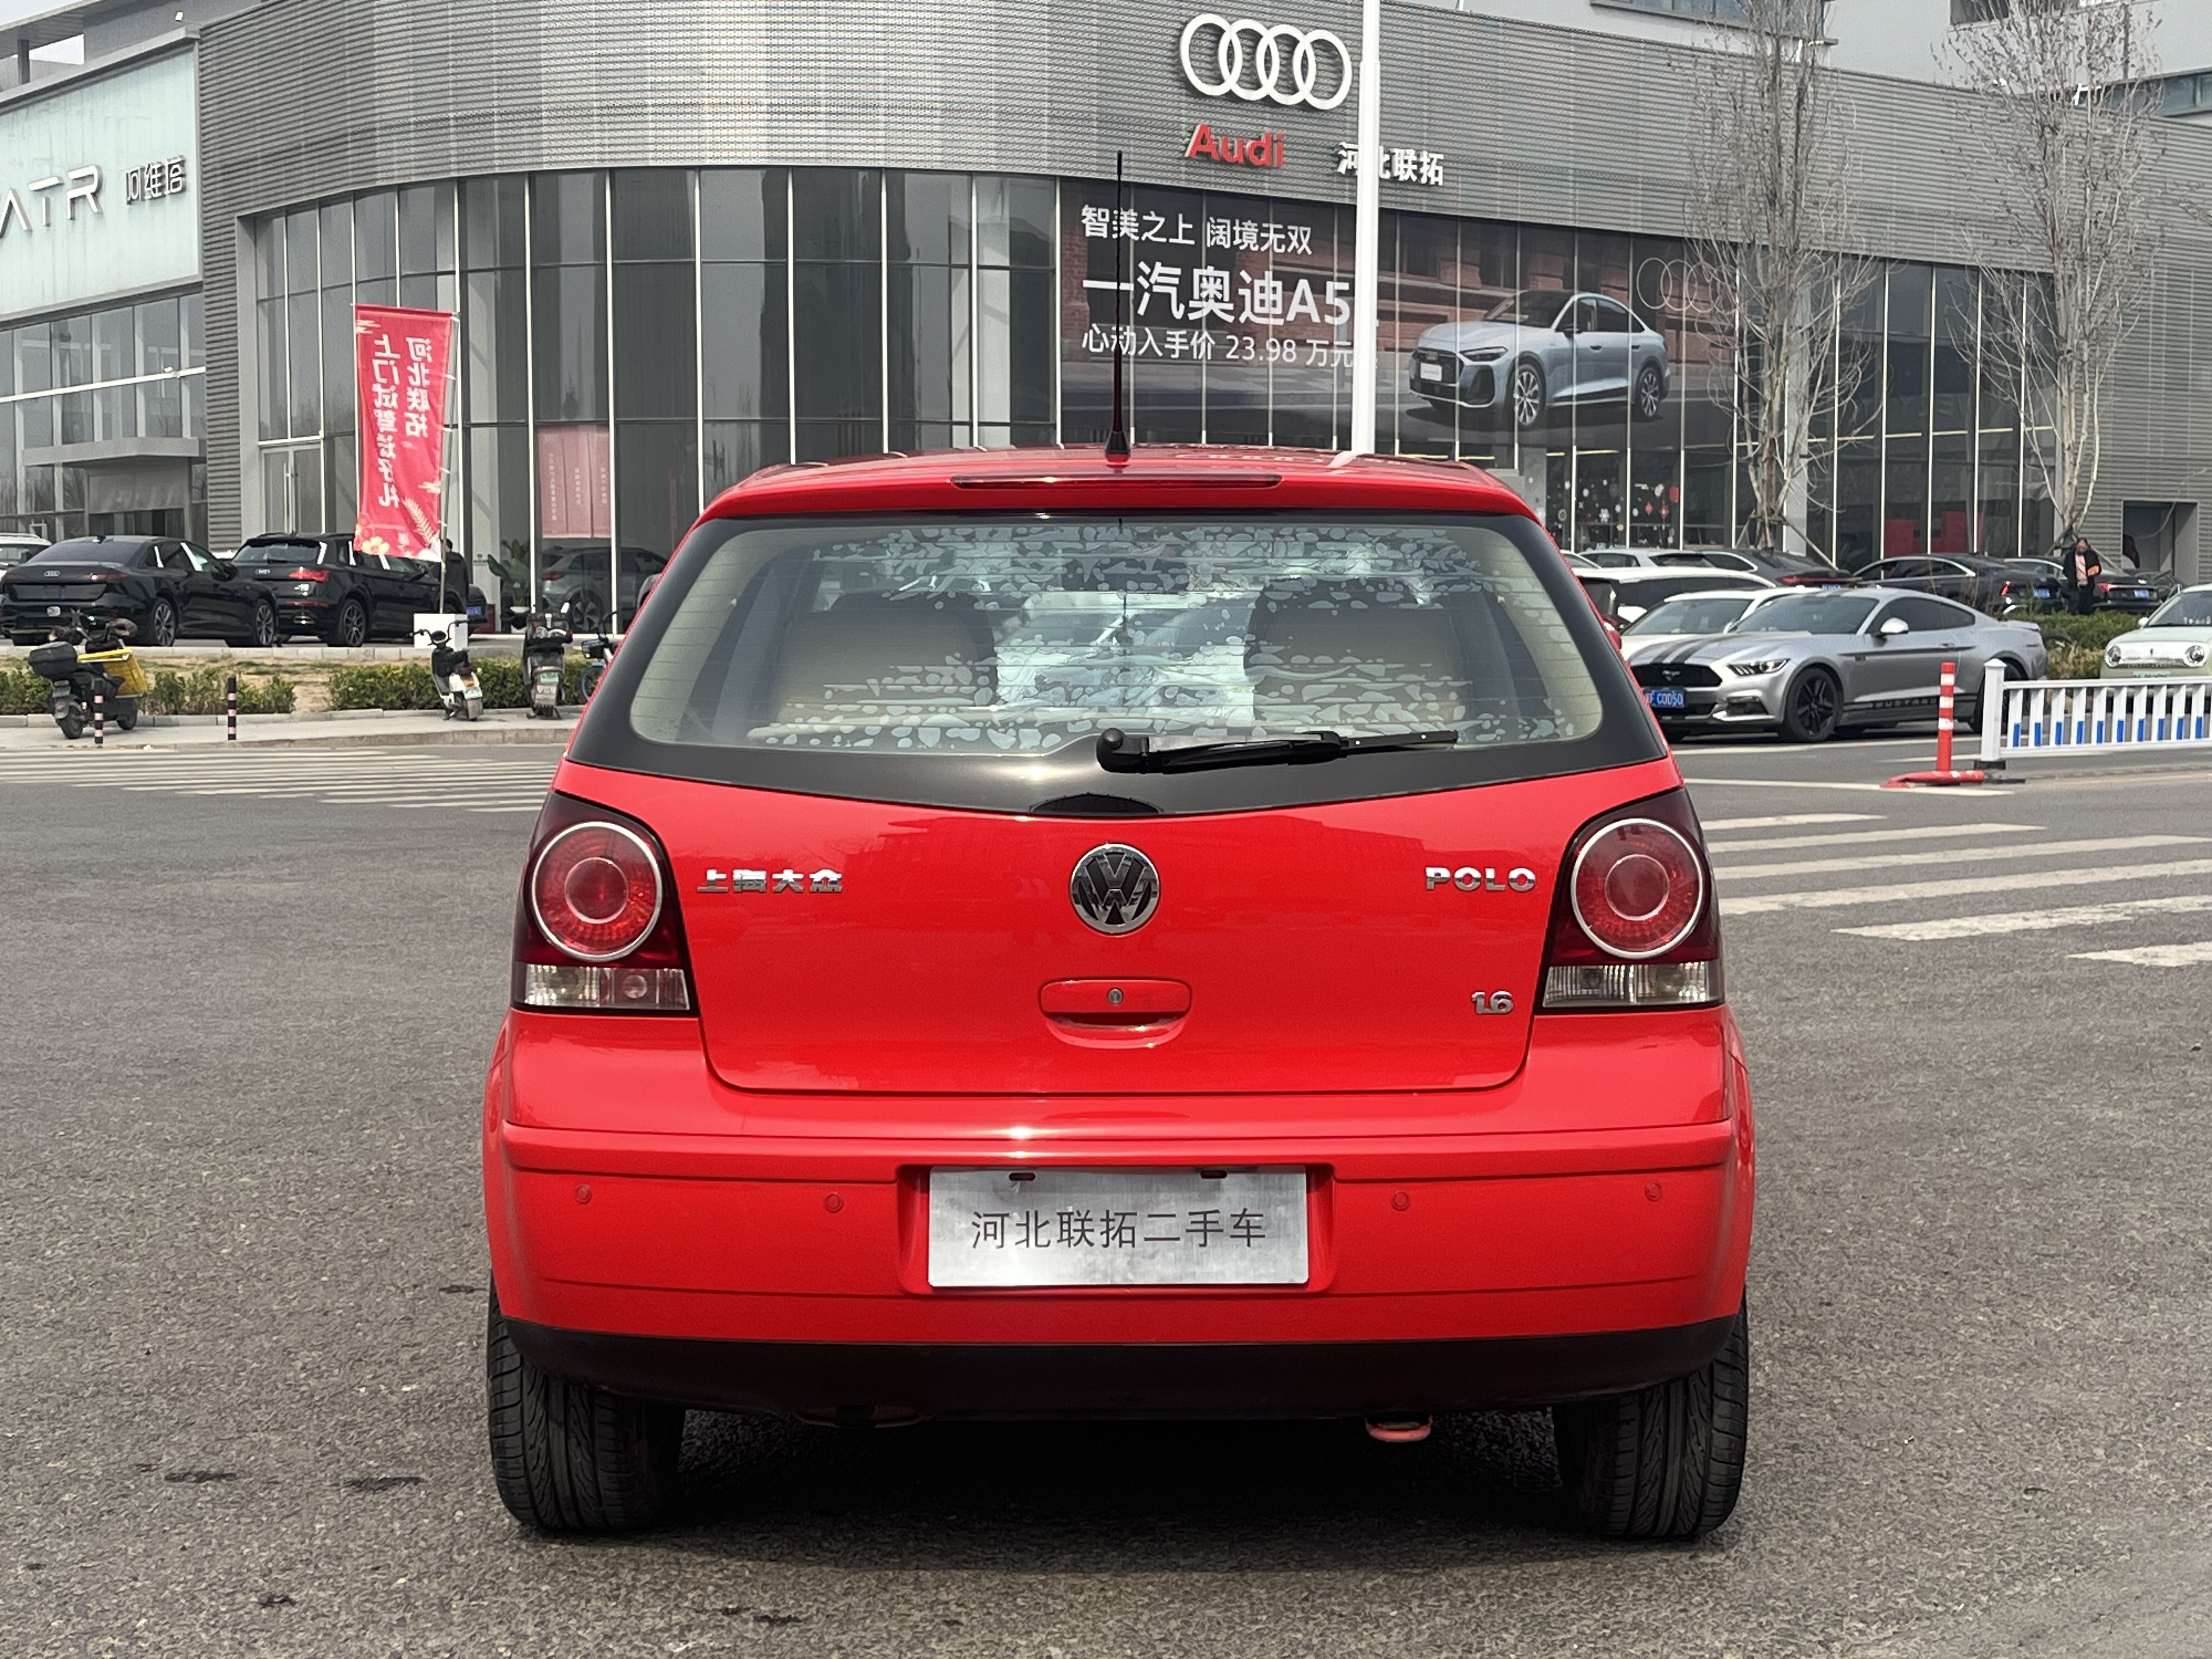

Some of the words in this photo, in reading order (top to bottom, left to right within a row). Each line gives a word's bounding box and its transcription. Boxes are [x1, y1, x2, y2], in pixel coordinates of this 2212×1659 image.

[1184, 123, 1285, 167] Audi
[1081, 204, 1195, 245] 智美之上
[1206, 217, 1312, 255] 阔境无双
[1082, 261, 1379, 327] 一汽奥迪A5
[1082, 323, 1215, 360] 心动入手价
[1226, 335, 1297, 363] 23.98
[1306, 338, 1378, 368] 万元
[697, 868, 843, 893] 上海大众
[1425, 866, 1536, 892] POLO
[972, 1207, 1266, 1249] 河北联拓二手车
